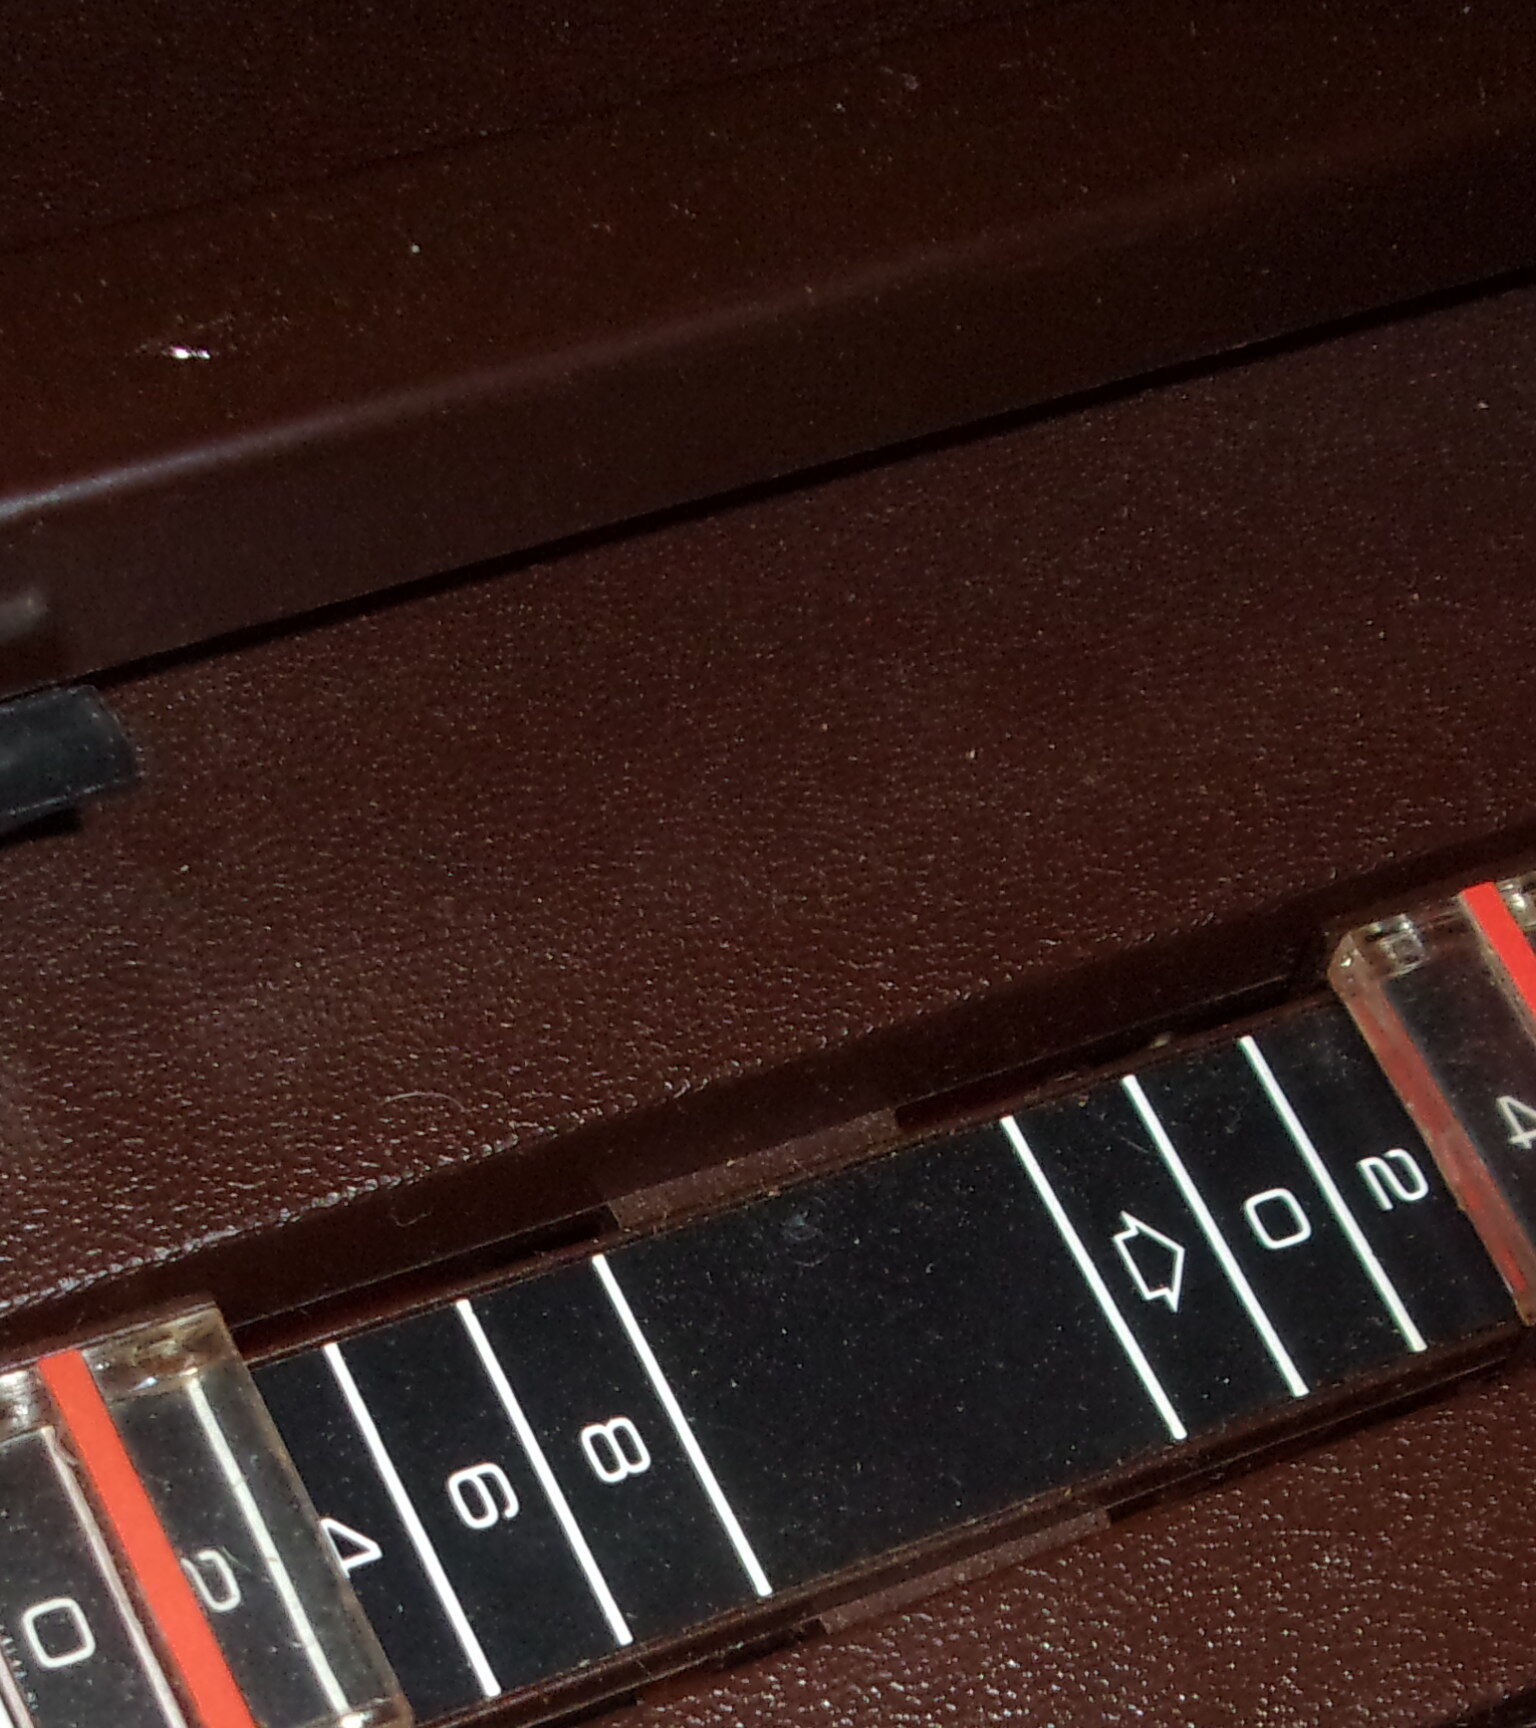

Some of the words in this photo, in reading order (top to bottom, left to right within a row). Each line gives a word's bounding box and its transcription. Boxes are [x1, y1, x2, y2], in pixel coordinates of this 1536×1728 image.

[1355, 1146, 1431, 1212] 2
[578, 1414, 653, 1485] 8
[445, 1460, 521, 1532] 6
